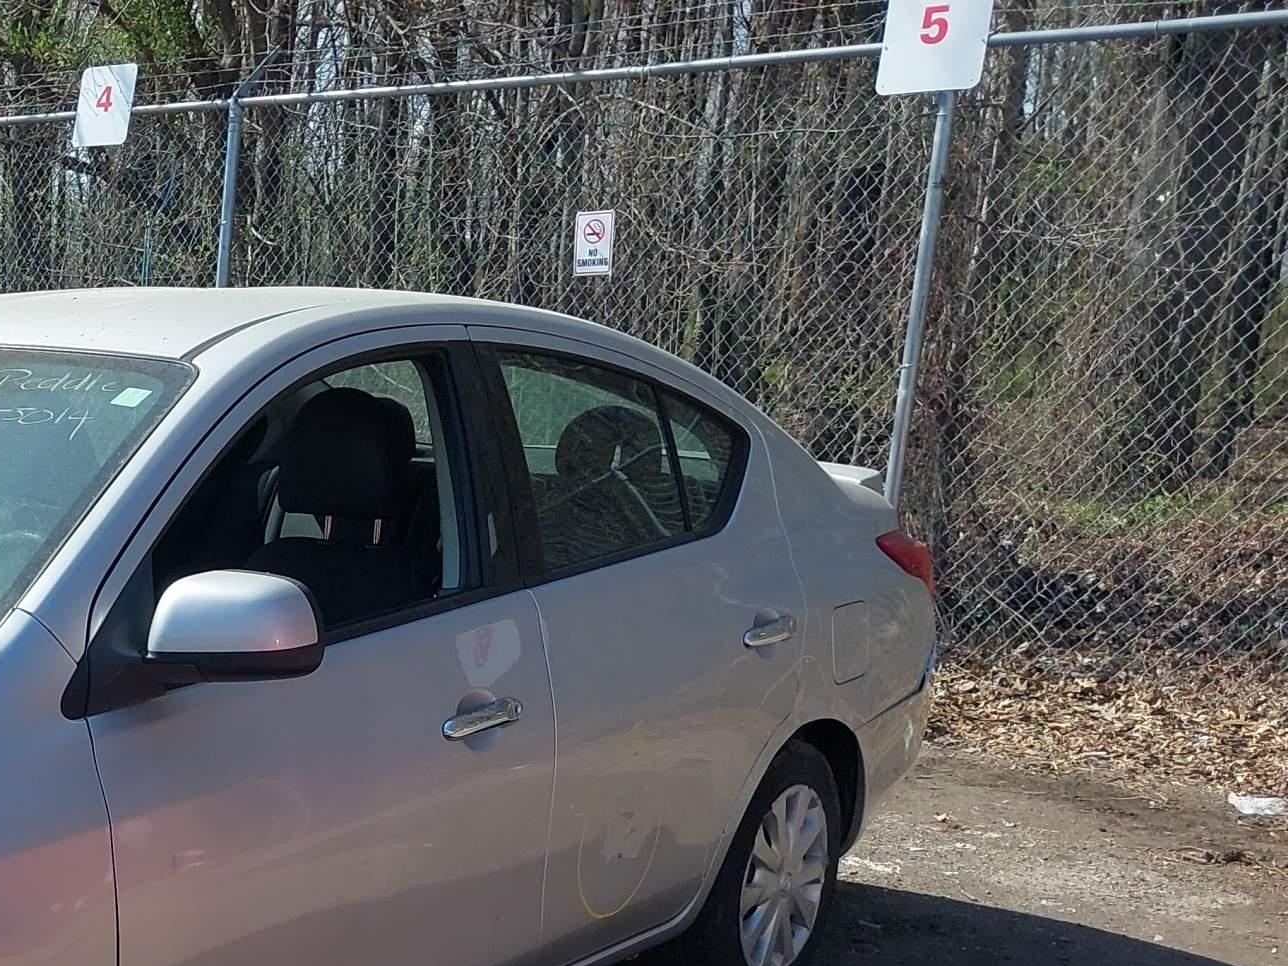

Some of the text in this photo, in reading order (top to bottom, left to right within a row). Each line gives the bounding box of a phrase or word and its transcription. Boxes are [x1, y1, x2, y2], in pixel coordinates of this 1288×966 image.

[920, 5, 950, 44] 5
[96, 86, 112, 112] 4
[588, 249, 598, 257] NO
[577, 258, 609, 268] SMOKING
